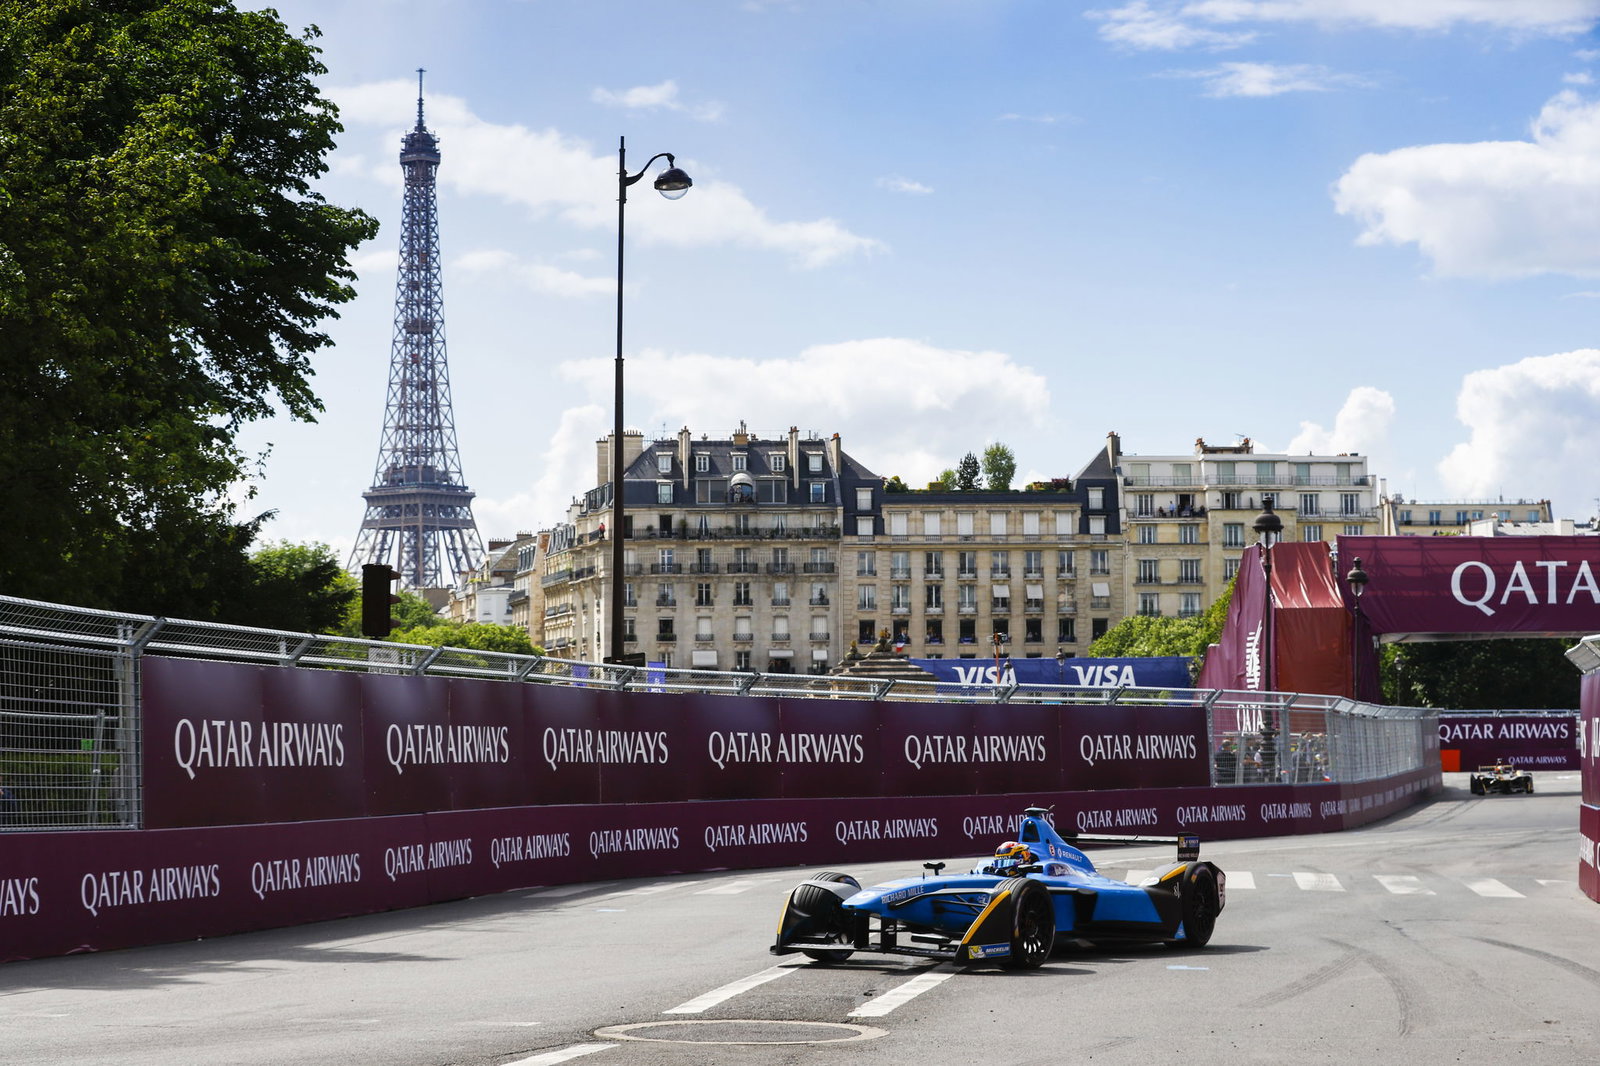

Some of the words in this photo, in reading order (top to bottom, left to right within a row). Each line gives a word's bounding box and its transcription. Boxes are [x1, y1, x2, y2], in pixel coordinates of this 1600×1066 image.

[1451, 560, 1600, 616] QATA
[952, 666, 1018, 689] VISA
[1070, 665, 1137, 688] VISA
[1236, 704, 1266, 736] QATA
[1439, 724, 1493, 742] QATAR
[1499, 724, 1568, 738] AIRWAYS
[174, 718, 253, 779] QATAR
[258, 722, 344, 766] AIRWAYS
[387, 724, 444, 774] QATAR
[447, 725, 508, 762] AIRWAYS
[544, 728, 593, 771] QATAR
[596, 730, 668, 763] AIRWAYS
[709, 731, 771, 769] QATAR
[777, 734, 863, 763] AIRWAYS
[905, 735, 967, 769] QATAR
[972, 736, 1045, 762] AIRWAYS
[1081, 735, 1132, 766] QATAR
[1136, 735, 1196, 759] AIRWAYS
[1508, 756, 1534, 765] QATAR
[964, 816, 1003, 839] QATAR
[1077, 810, 1112, 832] QATAR
[1115, 808, 1157, 826] AIRWAYS
[1177, 806, 1208, 826] QATAR
[1211, 805, 1245, 821] AIRWAYS
[1261, 804, 1287, 822] QATAR
[1289, 803, 1311, 817] AIRWAYS
[590, 830, 622, 859] QATAR
[625, 827, 678, 850] AIRWAYS
[705, 825, 745, 852] QATAR
[749, 822, 807, 844] AIRWAYS
[836, 820, 880, 845] QATAR
[884, 818, 937, 838] AIRWAYS
[385, 846, 424, 881] QATAR
[428, 839, 472, 869] AIRWAYS
[491, 837, 523, 868] QATAR
[525, 833, 569, 859] AIRWAYS
[1062, 850, 1083, 862] RENAULT
[82, 871, 144, 916] QATAR
[149, 864, 219, 902] AIRWAYS
[252, 859, 301, 899] QATAR
[305, 853, 360, 887] AIRWAYS
[0, 878, 39, 916] AYS
[881, 889, 907, 904] RICHARD
[907, 885, 925, 897] MILLE
[985, 946, 1010, 954] MICHELIN
